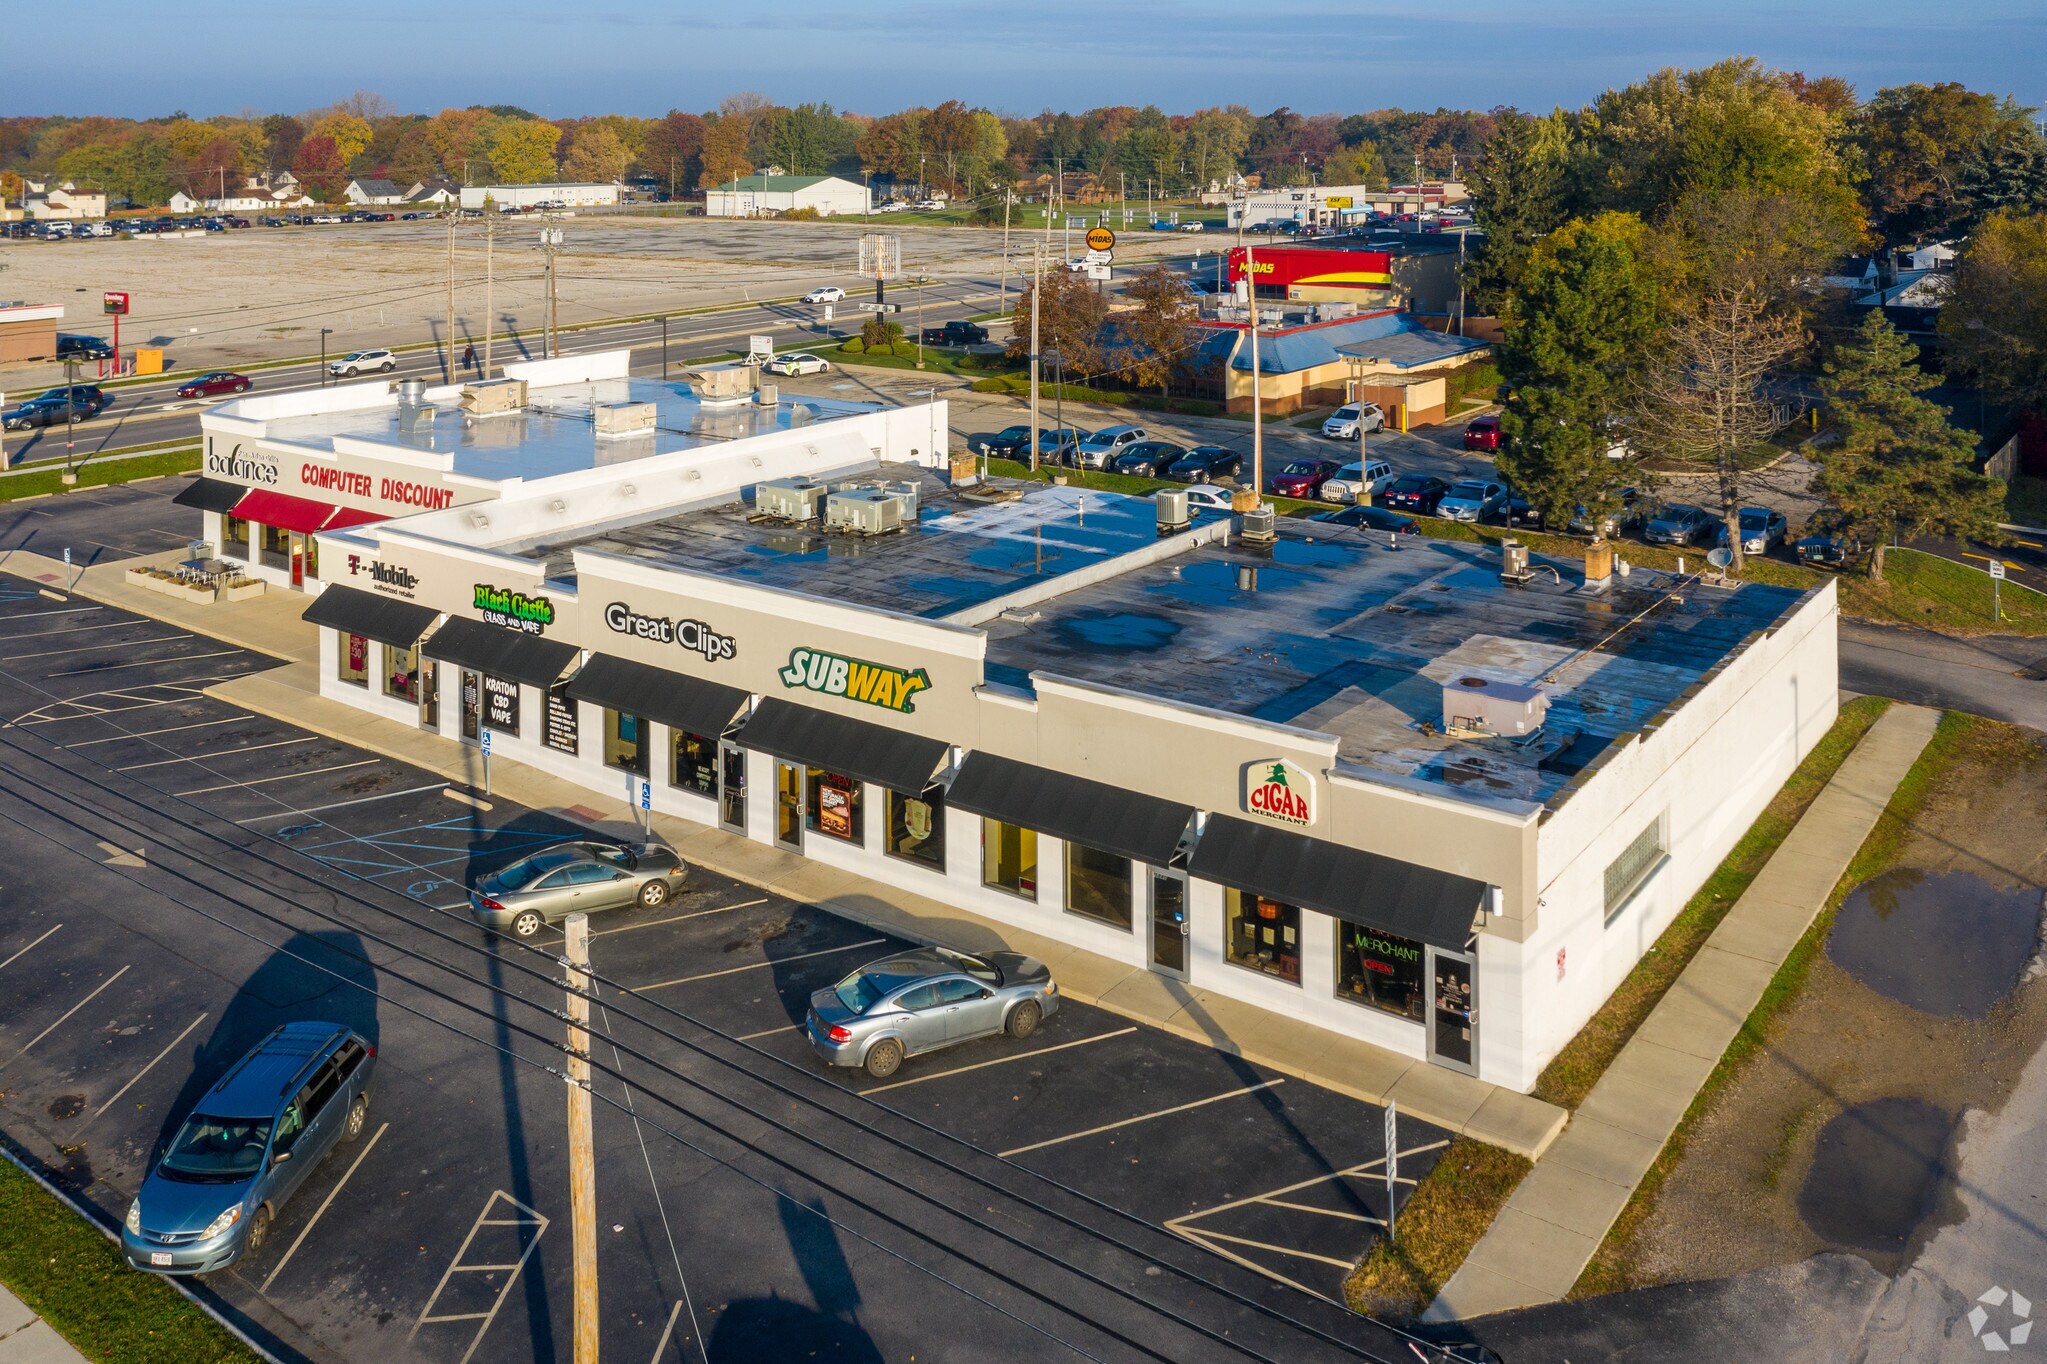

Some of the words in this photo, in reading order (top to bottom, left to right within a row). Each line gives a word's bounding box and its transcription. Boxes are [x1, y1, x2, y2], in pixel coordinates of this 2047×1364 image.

[1088, 235, 1112, 243] MIDAS
[1239, 262, 1274, 273] MDAS
[208, 436, 278, 485] balance
[301, 463, 372, 497] COMPUTER
[380, 477, 454, 510] DISCOUNT
[373, 584, 398, 595] authorized
[398, 590, 415, 599] retailer
[474, 585, 510, 614] Black
[511, 594, 551, 624] Castle
[484, 610, 506, 626] GLASS
[507, 617, 520, 628] AND
[521, 620, 540, 634] VAPE
[606, 604, 670, 642] Great
[677, 620, 733, 660] Clips
[485, 677, 517, 698] KRATOM
[782, 650, 925, 710] SUBWAY
[493, 694, 509, 709] CBD
[491, 706, 511, 724] VAPE
[827, 772, 849, 787] OPEN
[1250, 783, 1309, 820] CIGAR
[1251, 808, 1308, 826] MERCHANT
[1355, 933, 1420, 962] MERCHANT
[1363, 959, 1393, 974] OPEN
